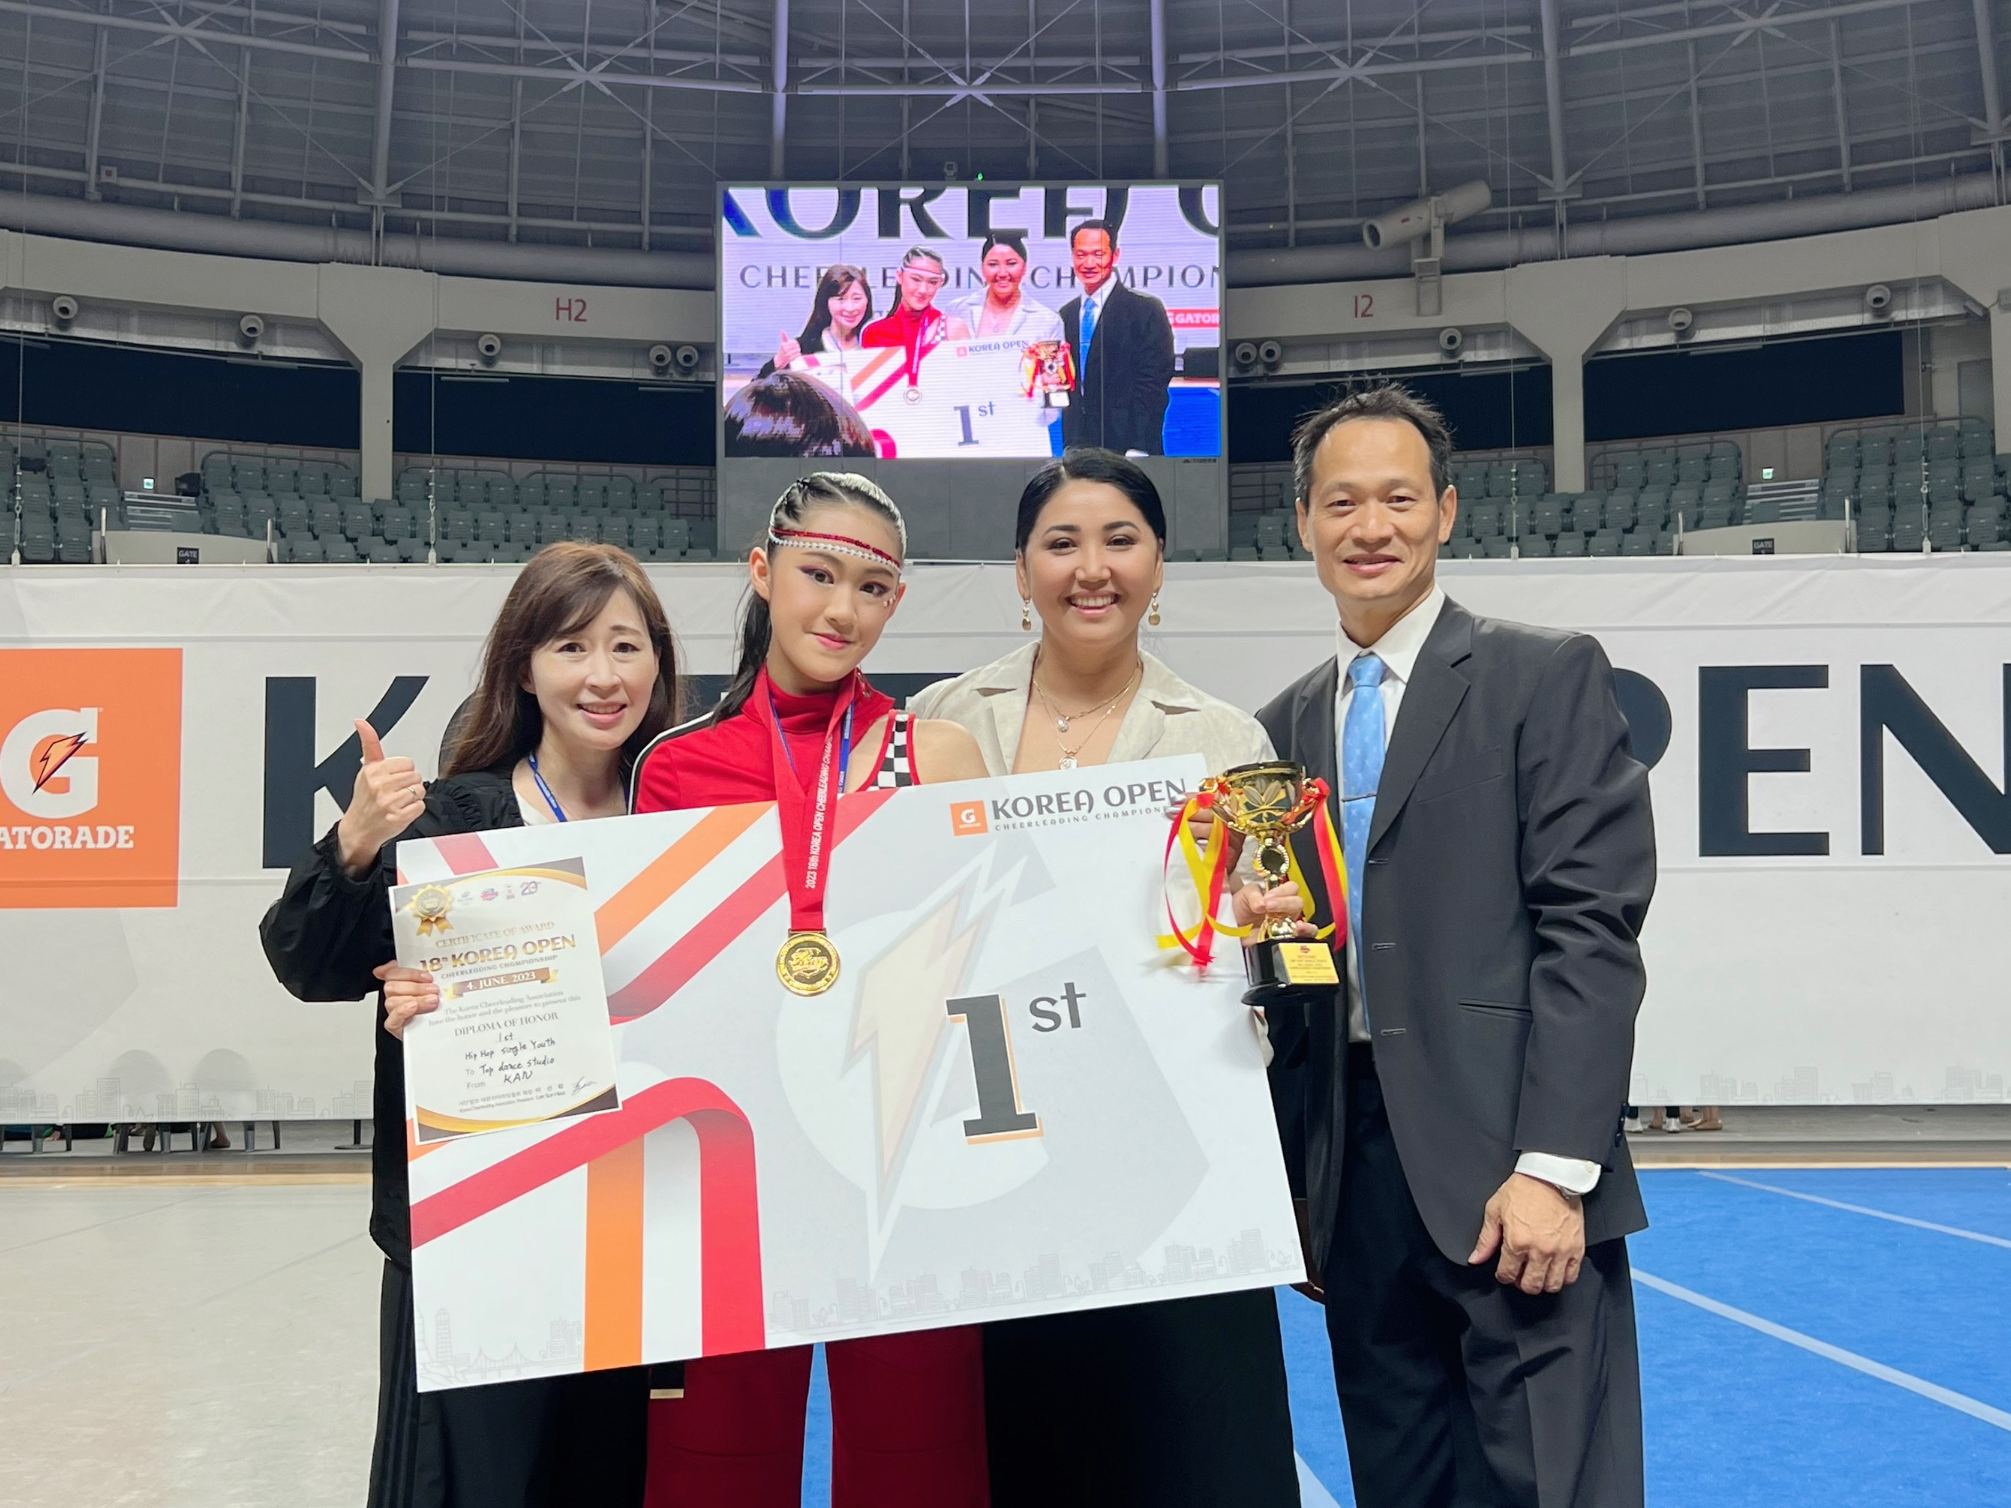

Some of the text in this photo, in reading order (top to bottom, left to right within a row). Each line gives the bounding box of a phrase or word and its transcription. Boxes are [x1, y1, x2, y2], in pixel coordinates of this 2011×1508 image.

[555, 297, 588, 322] H2
[968, 342, 1001, 353] KOREA
[1002, 340, 1028, 351] OPEN
[953, 401, 996, 446] 1st
[178, 550, 198, 558] GATE
[992, 778, 1186, 820] KOREA OPEN
[813, 810, 826, 831] OPEN
[995, 814, 1089, 832] CHEERLEADING
[0, 826, 135, 850] ATORADE
[809, 831, 823, 855] KOREA
[805, 871, 818, 889] 2023
[435, 921, 555, 949] CERTIFICATE OF AWARD
[451, 944, 518, 968] KOREA
[522, 934, 576, 956] OPEN
[441, 954, 558, 979] CHEERLEADING CHAMPIONSHIP
[466, 981, 478, 991] 4.
[512, 971, 536, 981] 2023
[458, 1003, 479, 1012] Korea
[479, 996, 525, 1008] Cheerleading
[526, 990, 564, 1001] Association
[454, 1011, 559, 1037] DIPLOMA OF HONOR
[464, 1052, 478, 1061] Hip
[480, 1049, 495, 1059] Hop
[530, 1037, 556, 1050] Youth
[526, 1054, 555, 1068] studio
[946, 981, 1087, 1140] 1st
[464, 1068, 475, 1076] To
[466, 1080, 486, 1090] From
